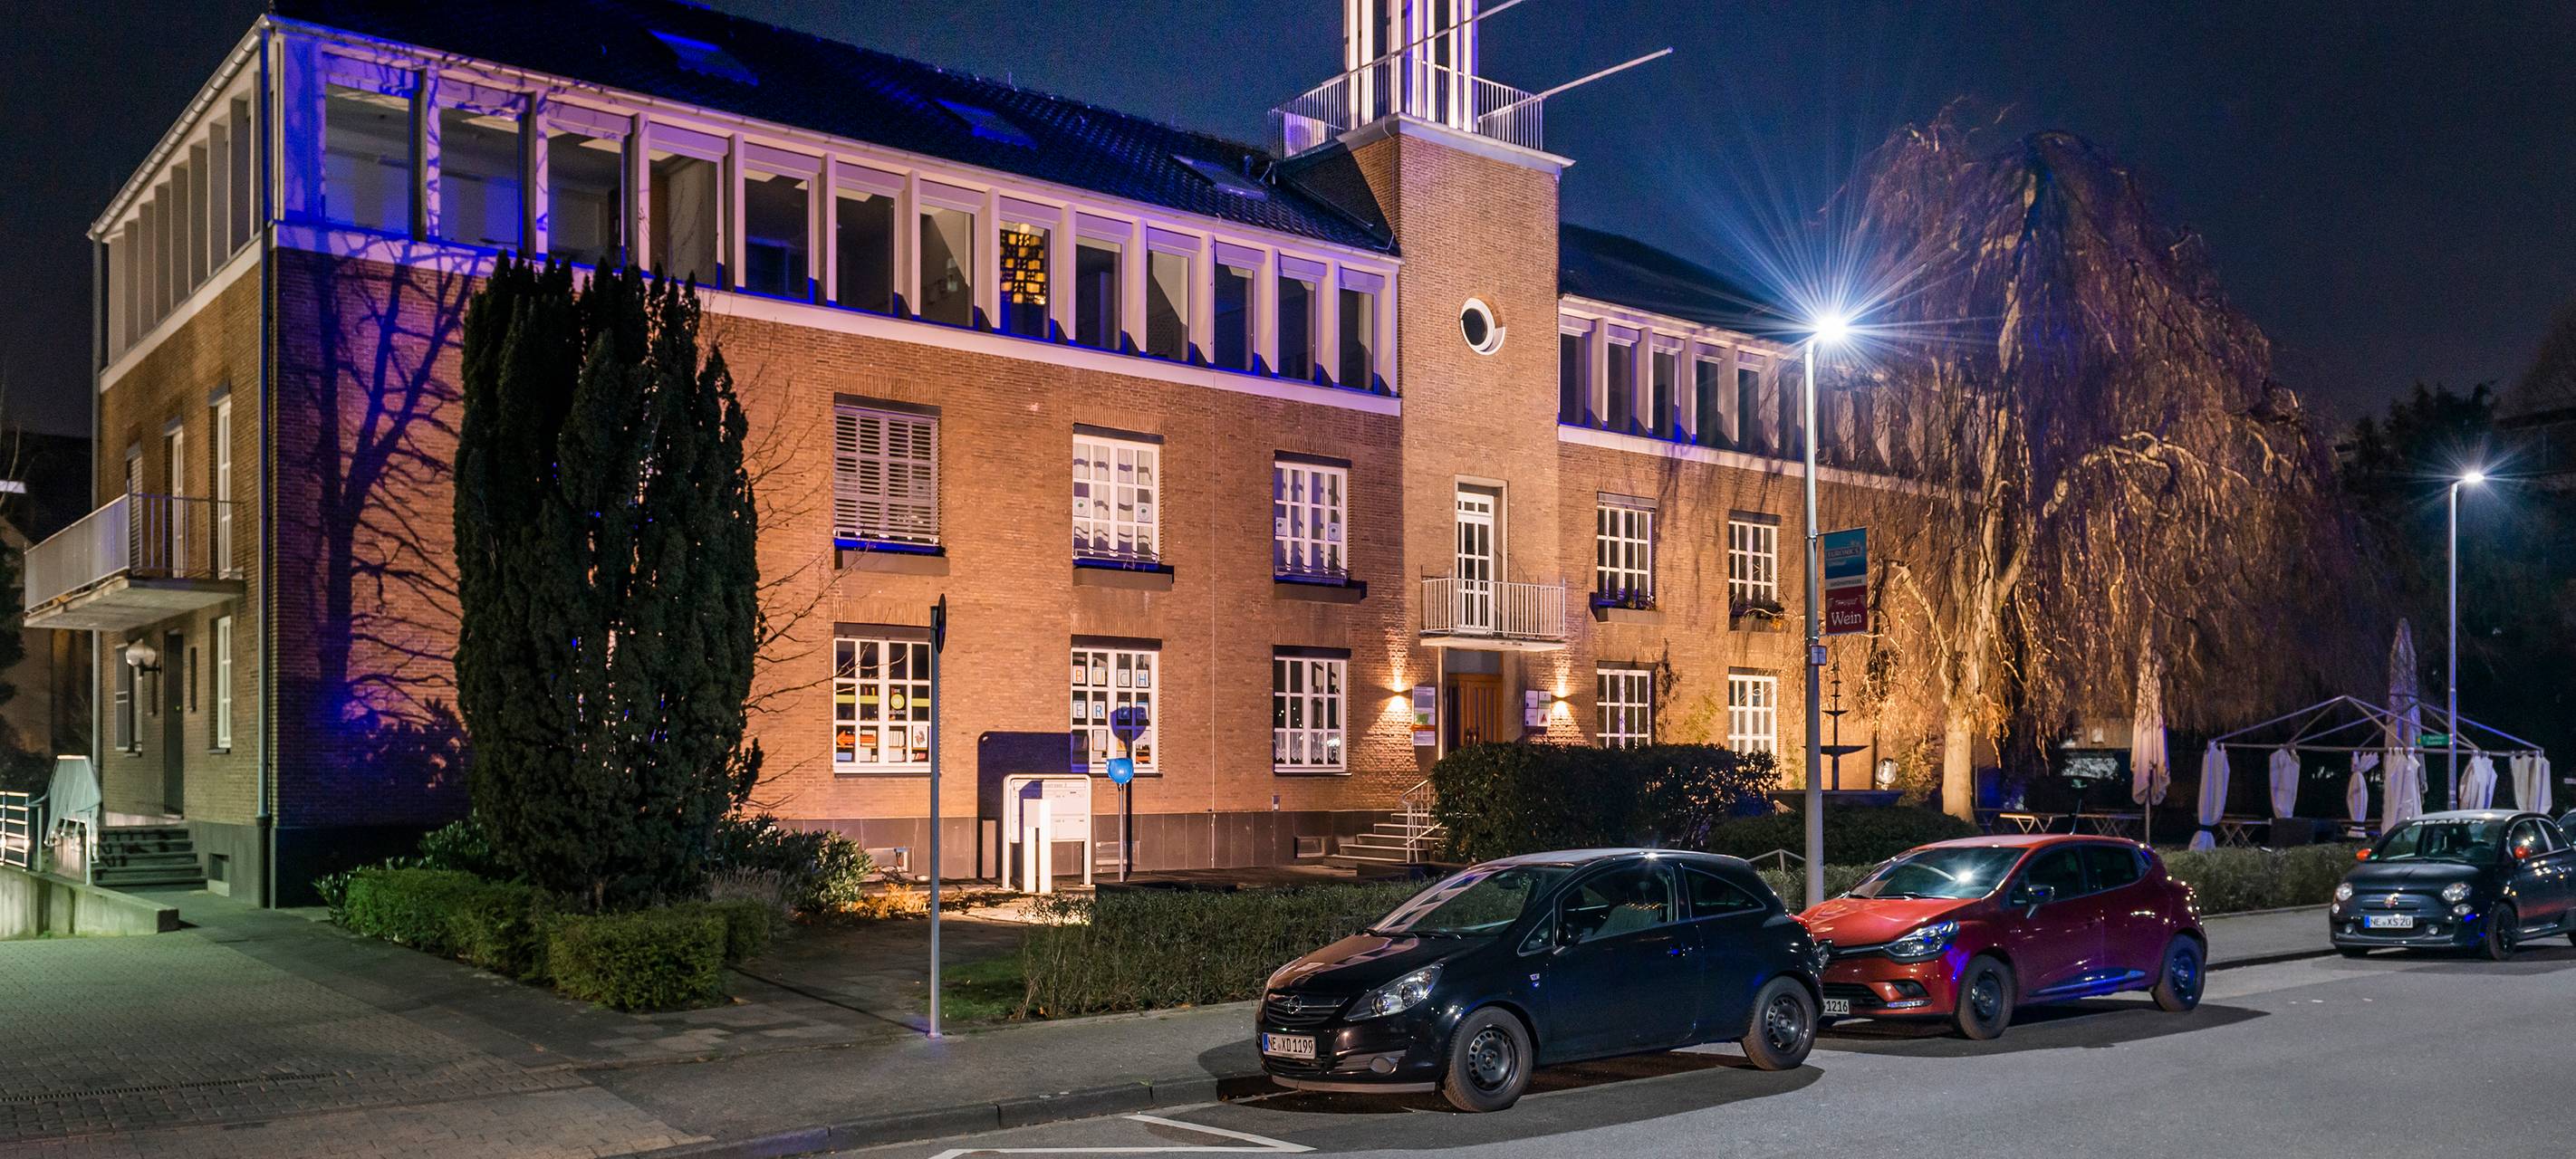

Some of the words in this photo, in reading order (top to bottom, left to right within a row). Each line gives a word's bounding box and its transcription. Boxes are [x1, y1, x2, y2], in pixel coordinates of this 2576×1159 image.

[1831, 610, 1862, 626] Wein
[1826, 1000, 1848, 1012] 1216
[1268, 1036, 1277, 1051] NE
